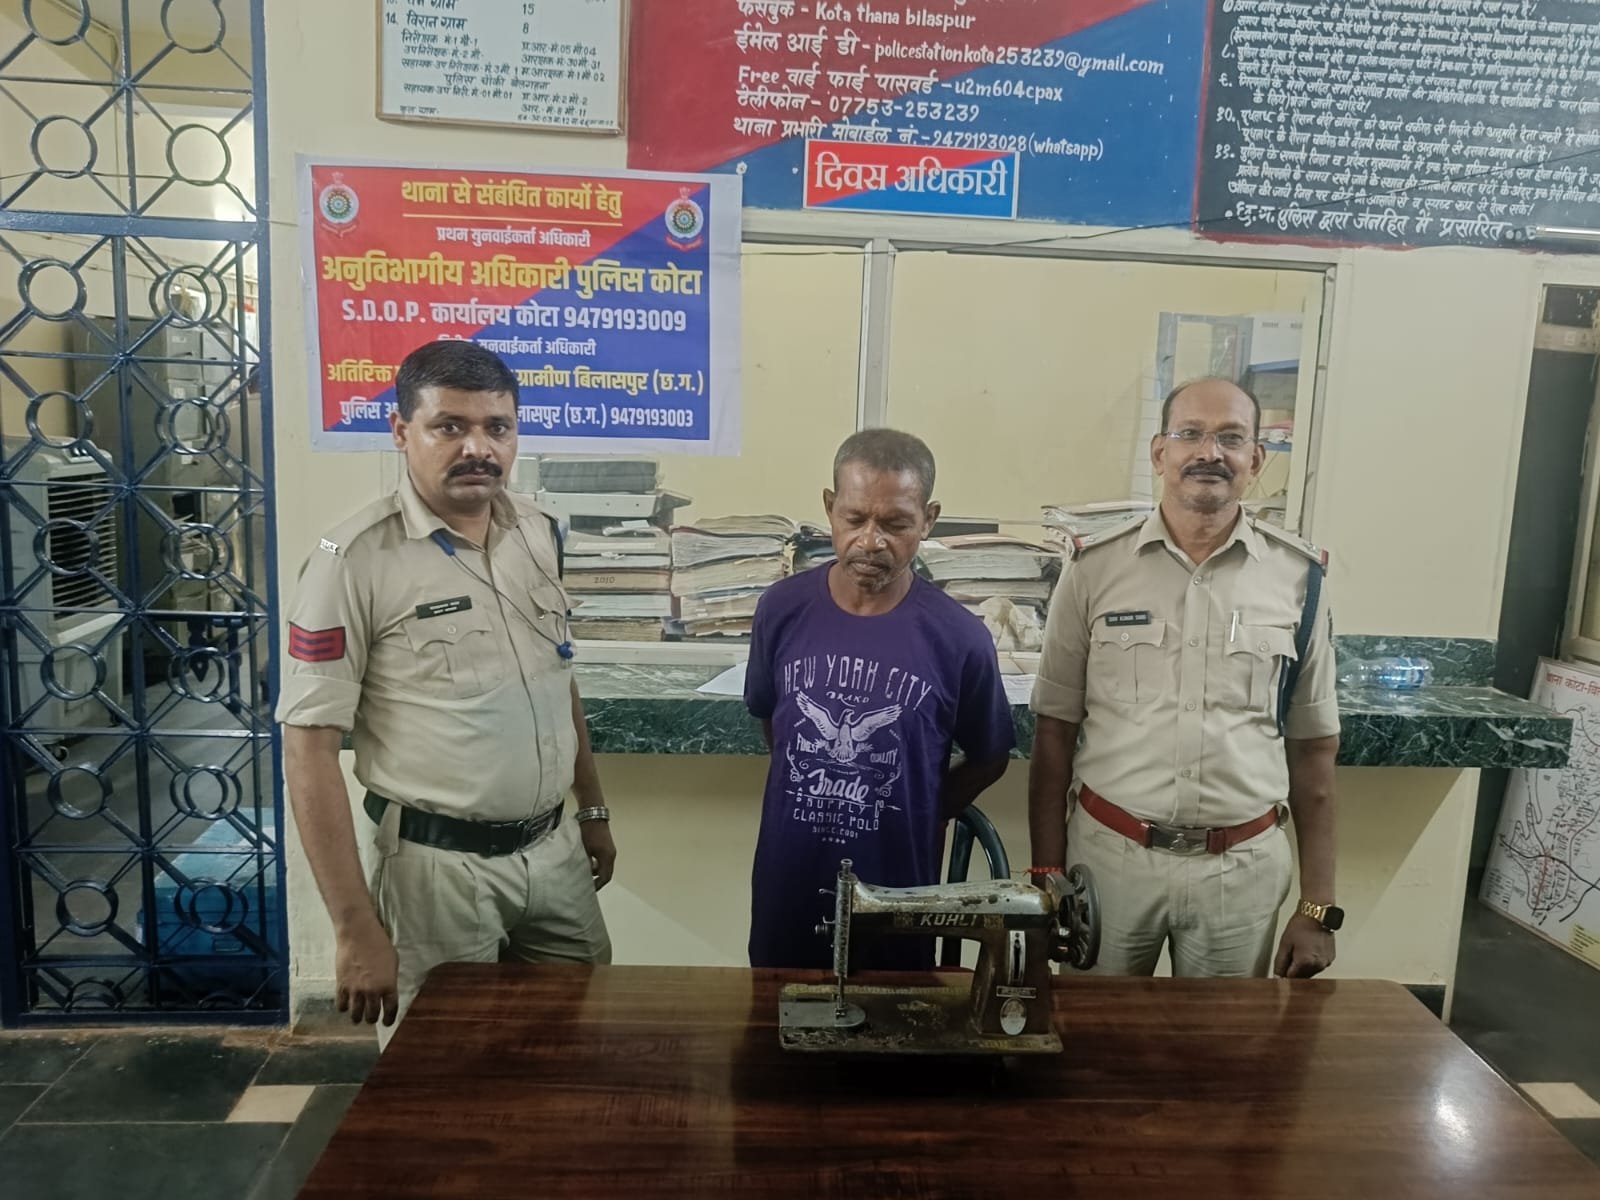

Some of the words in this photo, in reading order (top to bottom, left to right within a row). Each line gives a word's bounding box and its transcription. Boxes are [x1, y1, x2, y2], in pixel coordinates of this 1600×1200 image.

[440, 16, 467, 31] ग्राम
[522, 23, 529, 34] 8
[522, 4, 535, 15] 15
[736, 0, 796, 24] फसबुक
[815, 1, 852, 22] Kota
[856, 4, 900, 25] thana
[905, 8, 976, 33] bilaspur
[734, 22, 782, 53] ईमेल
[787, 26, 828, 58] आई
[835, 28, 861, 56] डी
[444, 73, 474, 89] पुलिस
[738, 65, 780, 85] Free
[785, 61, 821, 90] वाई
[826, 64, 871, 95] फाई
[875, 69, 939, 97] पासवर्ड
[829, 95, 980, 123] 07753-253239
[1277, 106, 1290, 123] के
[1433, 117, 1446, 135] से
[1471, 121, 1486, 137] की
[733, 116, 777, 138] थाना
[781, 115, 828, 139] प्रभारी
[1276, 125, 1287, 142] के
[1451, 140, 1464, 156] से
[1266, 143, 1280, 160] के
[814, 151, 887, 191] दिवस
[895, 156, 1008, 197] अधिकारी
[1292, 164, 1305, 181] के
[402, 180, 449, 204] थाना
[452, 178, 471, 205] से
[476, 180, 541, 208] संबंधित
[595, 183, 623, 218] हेतु
[1315, 189, 1331, 201] पर
[1277, 201, 1318, 231] पुलिस
[1318, 208, 1353, 232] द्वारा
[1353, 207, 1411, 238] जनहित
[1416, 210, 1434, 234] में
[1438, 212, 1513, 241] प्रसारित
[436, 226, 469, 242] प्रथम
[539, 227, 591, 248] अधिकारी
[322, 250, 464, 291] अनुविभागीय
[471, 253, 570, 291] अधिकारी
[574, 257, 645, 299] पुलिस
[649, 261, 703, 296] कोटा
[342, 298, 427, 323] S.D.O.P.
[429, 297, 511, 327] कार्यालय
[514, 299, 560, 328] कोटा
[564, 310, 686, 332] 9479193009
[477, 336, 543, 355] सनवाईकर्ता
[545, 338, 597, 356] अधिकारी
[327, 358, 394, 383] अतिरिक्त
[515, 365, 571, 388] ग्रामीण
[573, 366, 649, 396] बिलासपुर
[652, 368, 704, 396] (छ.ग.)
[339, 395, 382, 425] पुलिस
[517, 404, 561, 429] लासपुर
[564, 402, 607, 428] (छ.ग.)
[610, 407, 694, 428] 9479193003
[594, 576, 616, 584] 2010
[784, 655, 817, 696] NEW
[824, 653, 880, 693] YORK
[884, 666, 933, 711] CITY
[807, 768, 870, 803] Trade
[793, 808, 845, 825] CLASSIC
[849, 816, 879, 831] POLO
[806, 798, 866, 815] SUPPLY
